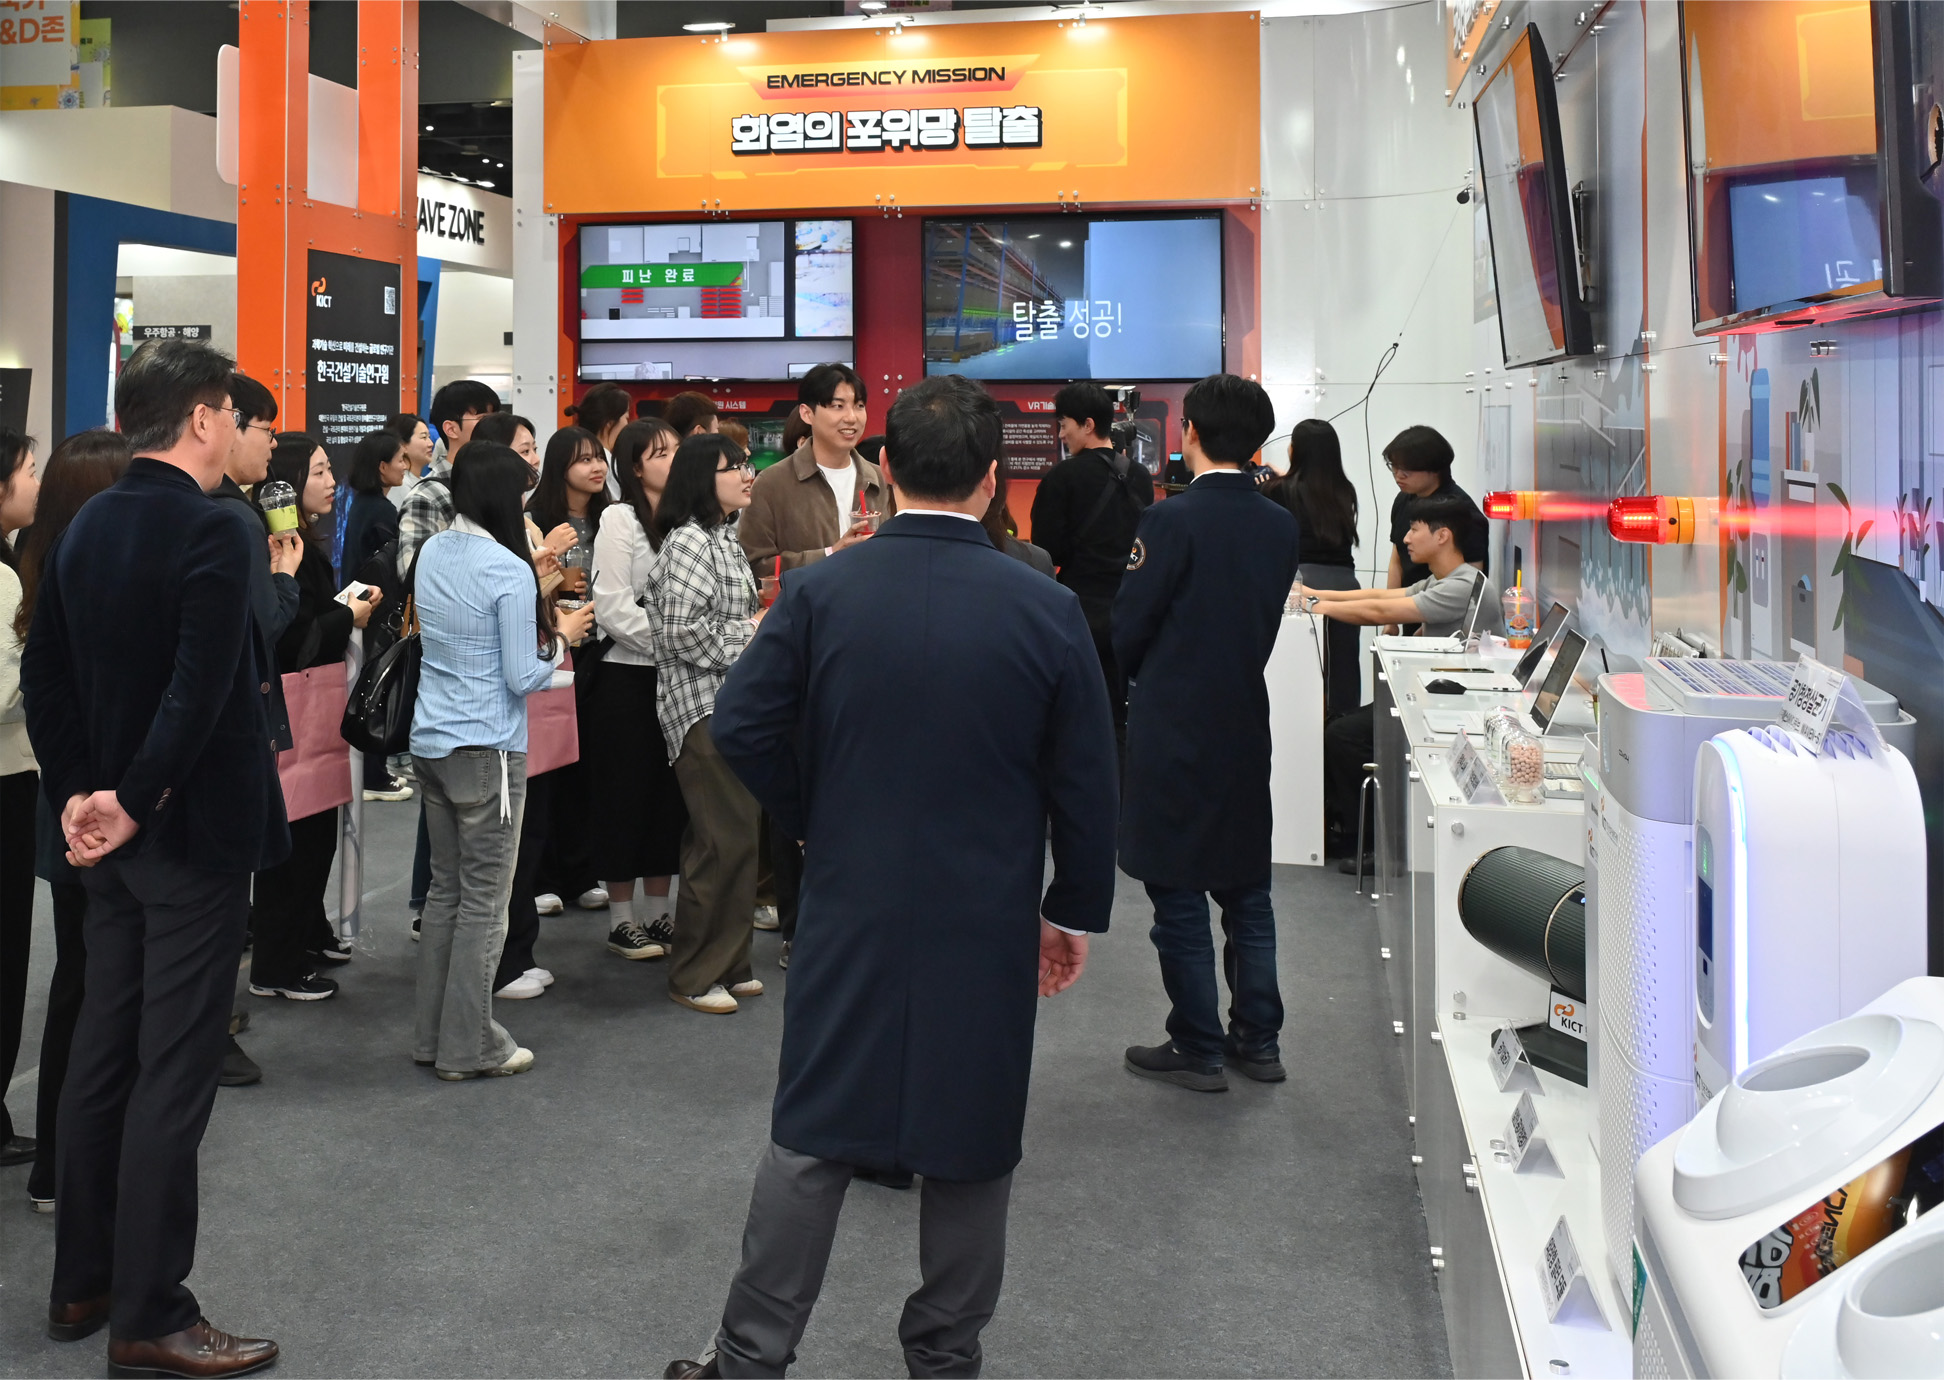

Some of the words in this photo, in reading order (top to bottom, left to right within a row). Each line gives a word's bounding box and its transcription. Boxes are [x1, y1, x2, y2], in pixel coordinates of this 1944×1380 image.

[766, 70, 908, 90] EMERGENCY
[911, 66, 1006, 86] MISSION
[731, 112, 844, 156] 화염의
[846, 107, 961, 152] 포위망
[962, 104, 1044, 149] 탈출
[417, 196, 446, 237] AVE
[447, 204, 486, 246] ZONE
[621, 268, 653, 284] 피난
[664, 267, 696, 284] 완료
[315, 294, 332, 308] KICT
[144, 326, 176, 338] 우주항공
[182, 326, 200, 338] 해양
[1012, 299, 1061, 341] 탈출
[1068, 299, 1122, 339] 성공!
[316, 359, 389, 384] 한국건설기술연구원
[725, 400, 747, 410] 시스템
[1788, 679, 1831, 722] 공기청정살균기
[1561, 1016, 1584, 1034] KICT
